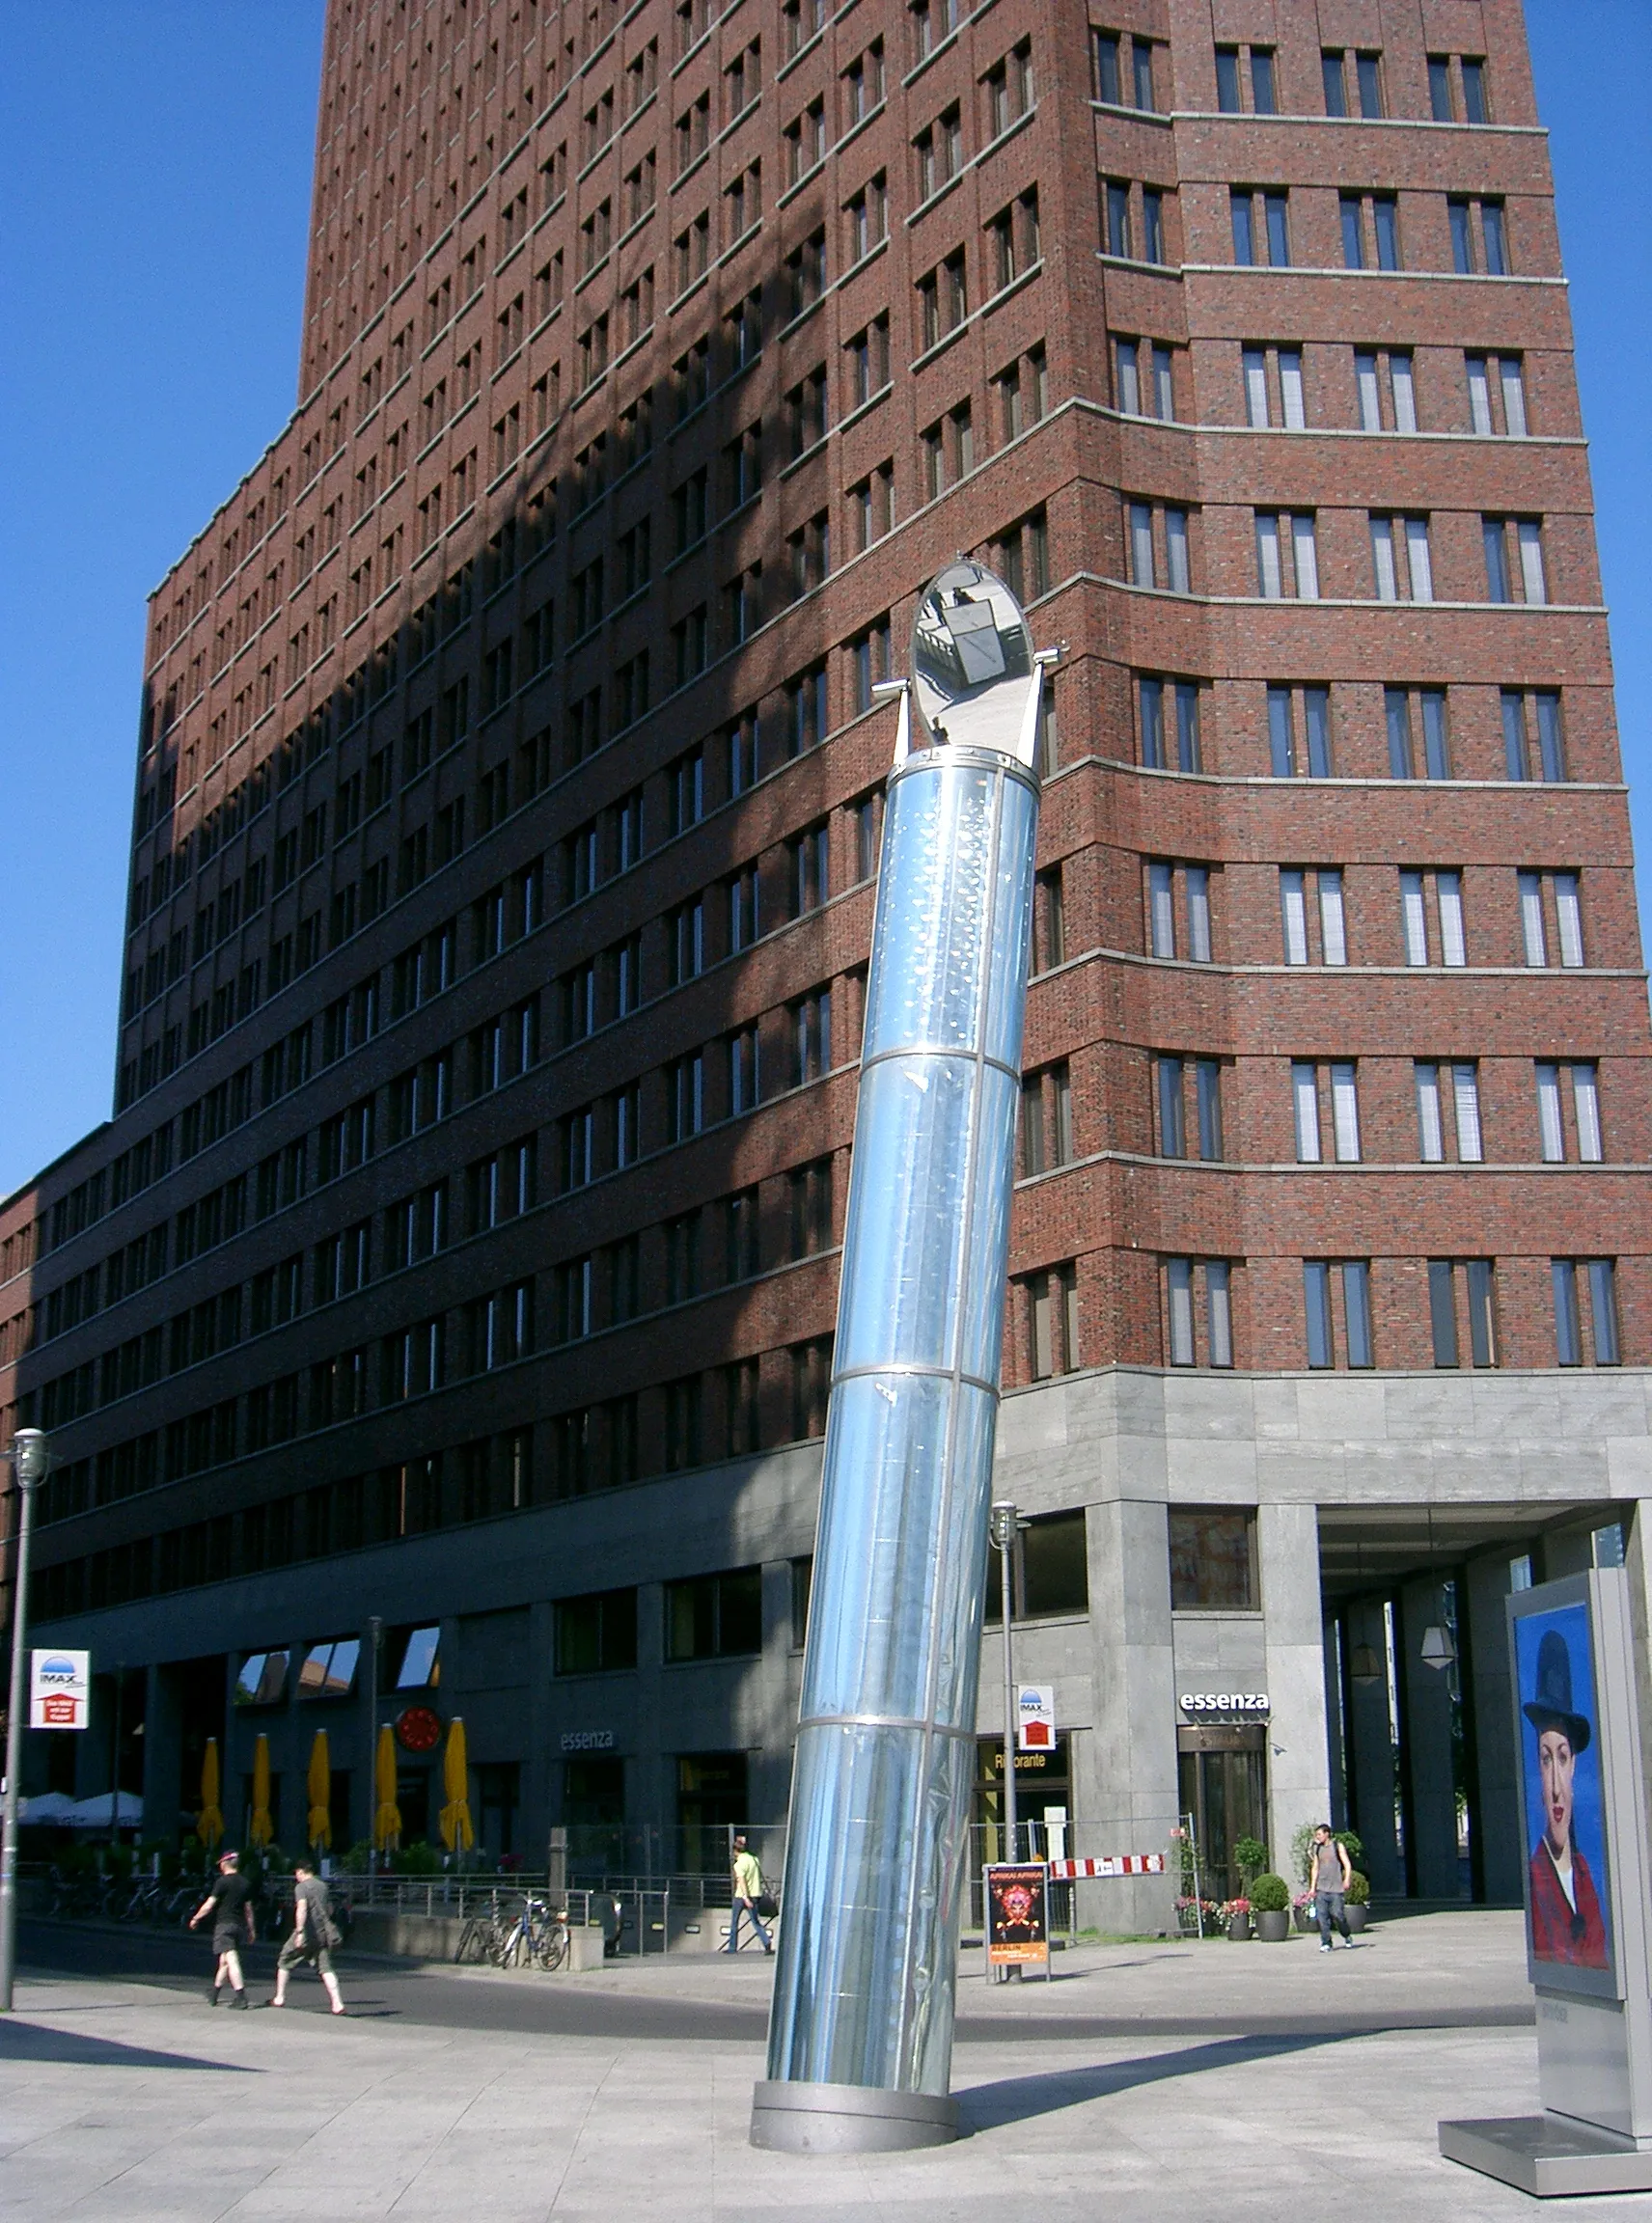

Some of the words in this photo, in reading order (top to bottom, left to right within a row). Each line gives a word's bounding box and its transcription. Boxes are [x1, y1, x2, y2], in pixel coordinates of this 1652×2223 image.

[40, 1674, 76, 1685] IMAX
[1179, 1693, 1269, 1711] essenza
[561, 1731, 613, 1750] essenza
[995, 1753, 1046, 1769] Riorante
